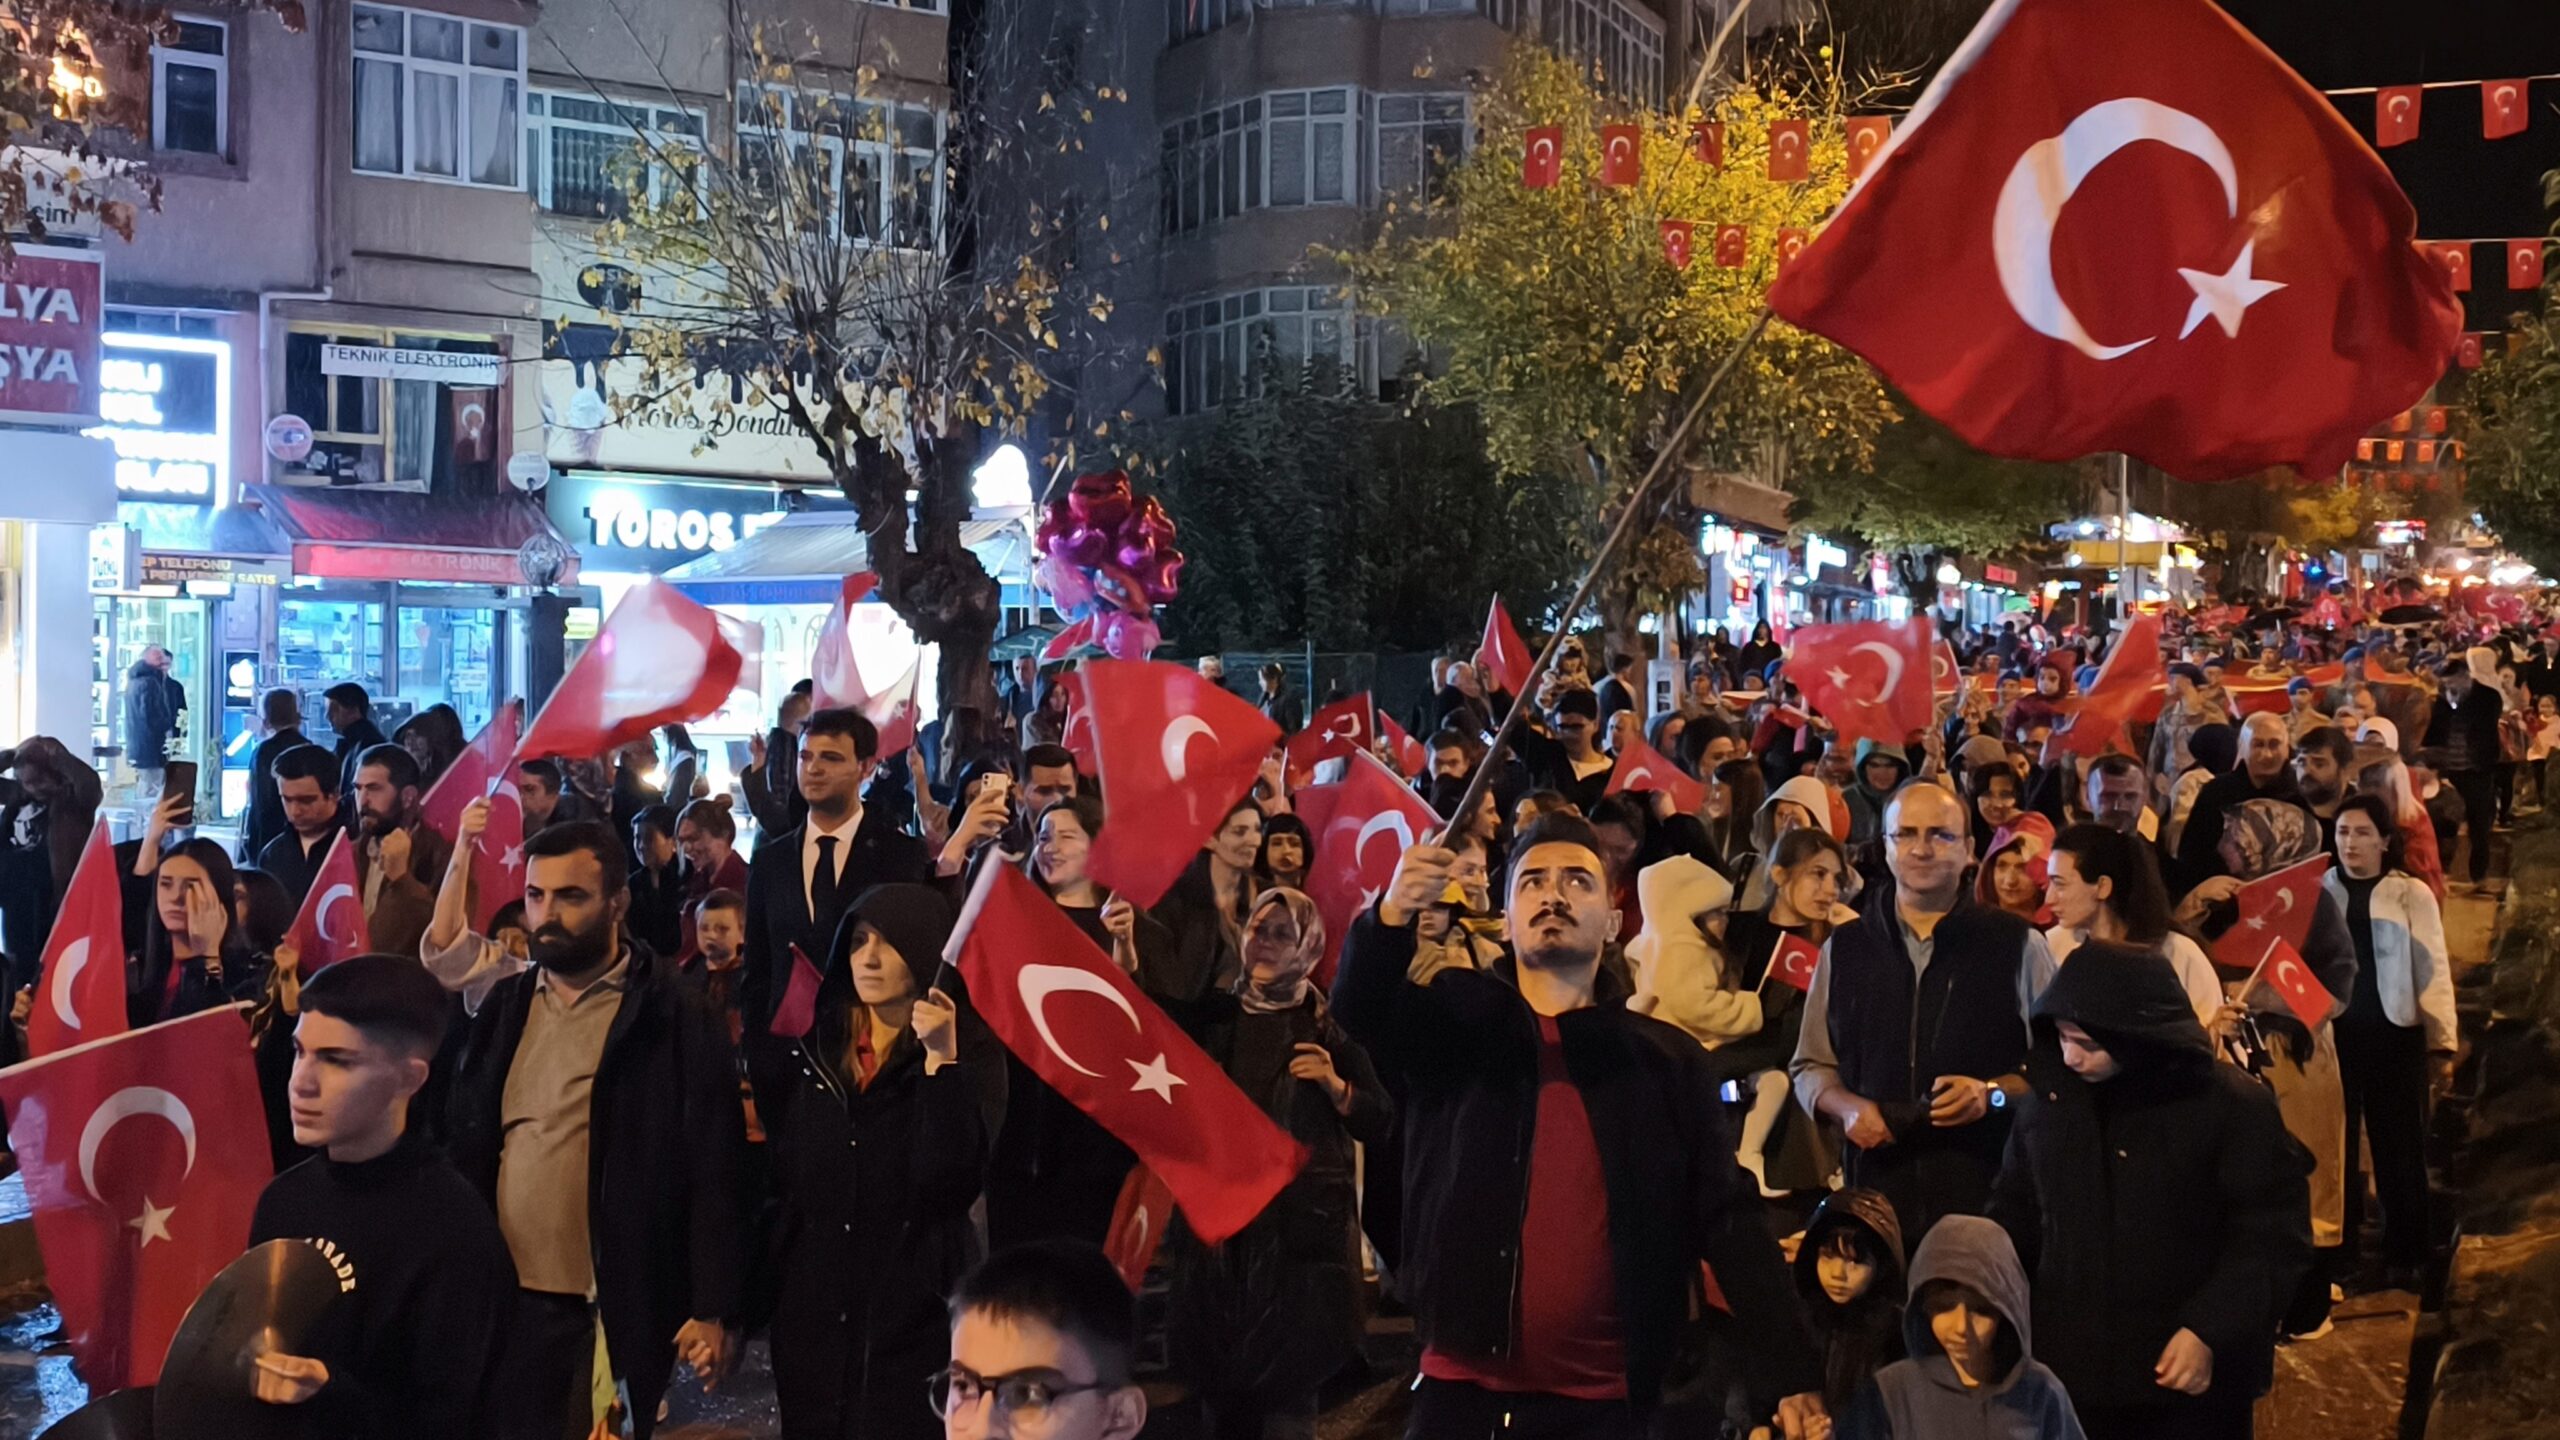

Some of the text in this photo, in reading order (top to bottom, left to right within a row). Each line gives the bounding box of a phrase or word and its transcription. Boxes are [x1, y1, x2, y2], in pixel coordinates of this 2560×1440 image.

[0, 282, 81, 324] LYA
[587, 502, 736, 552] TOROS
[158, 557, 232, 571] TELEFONU
